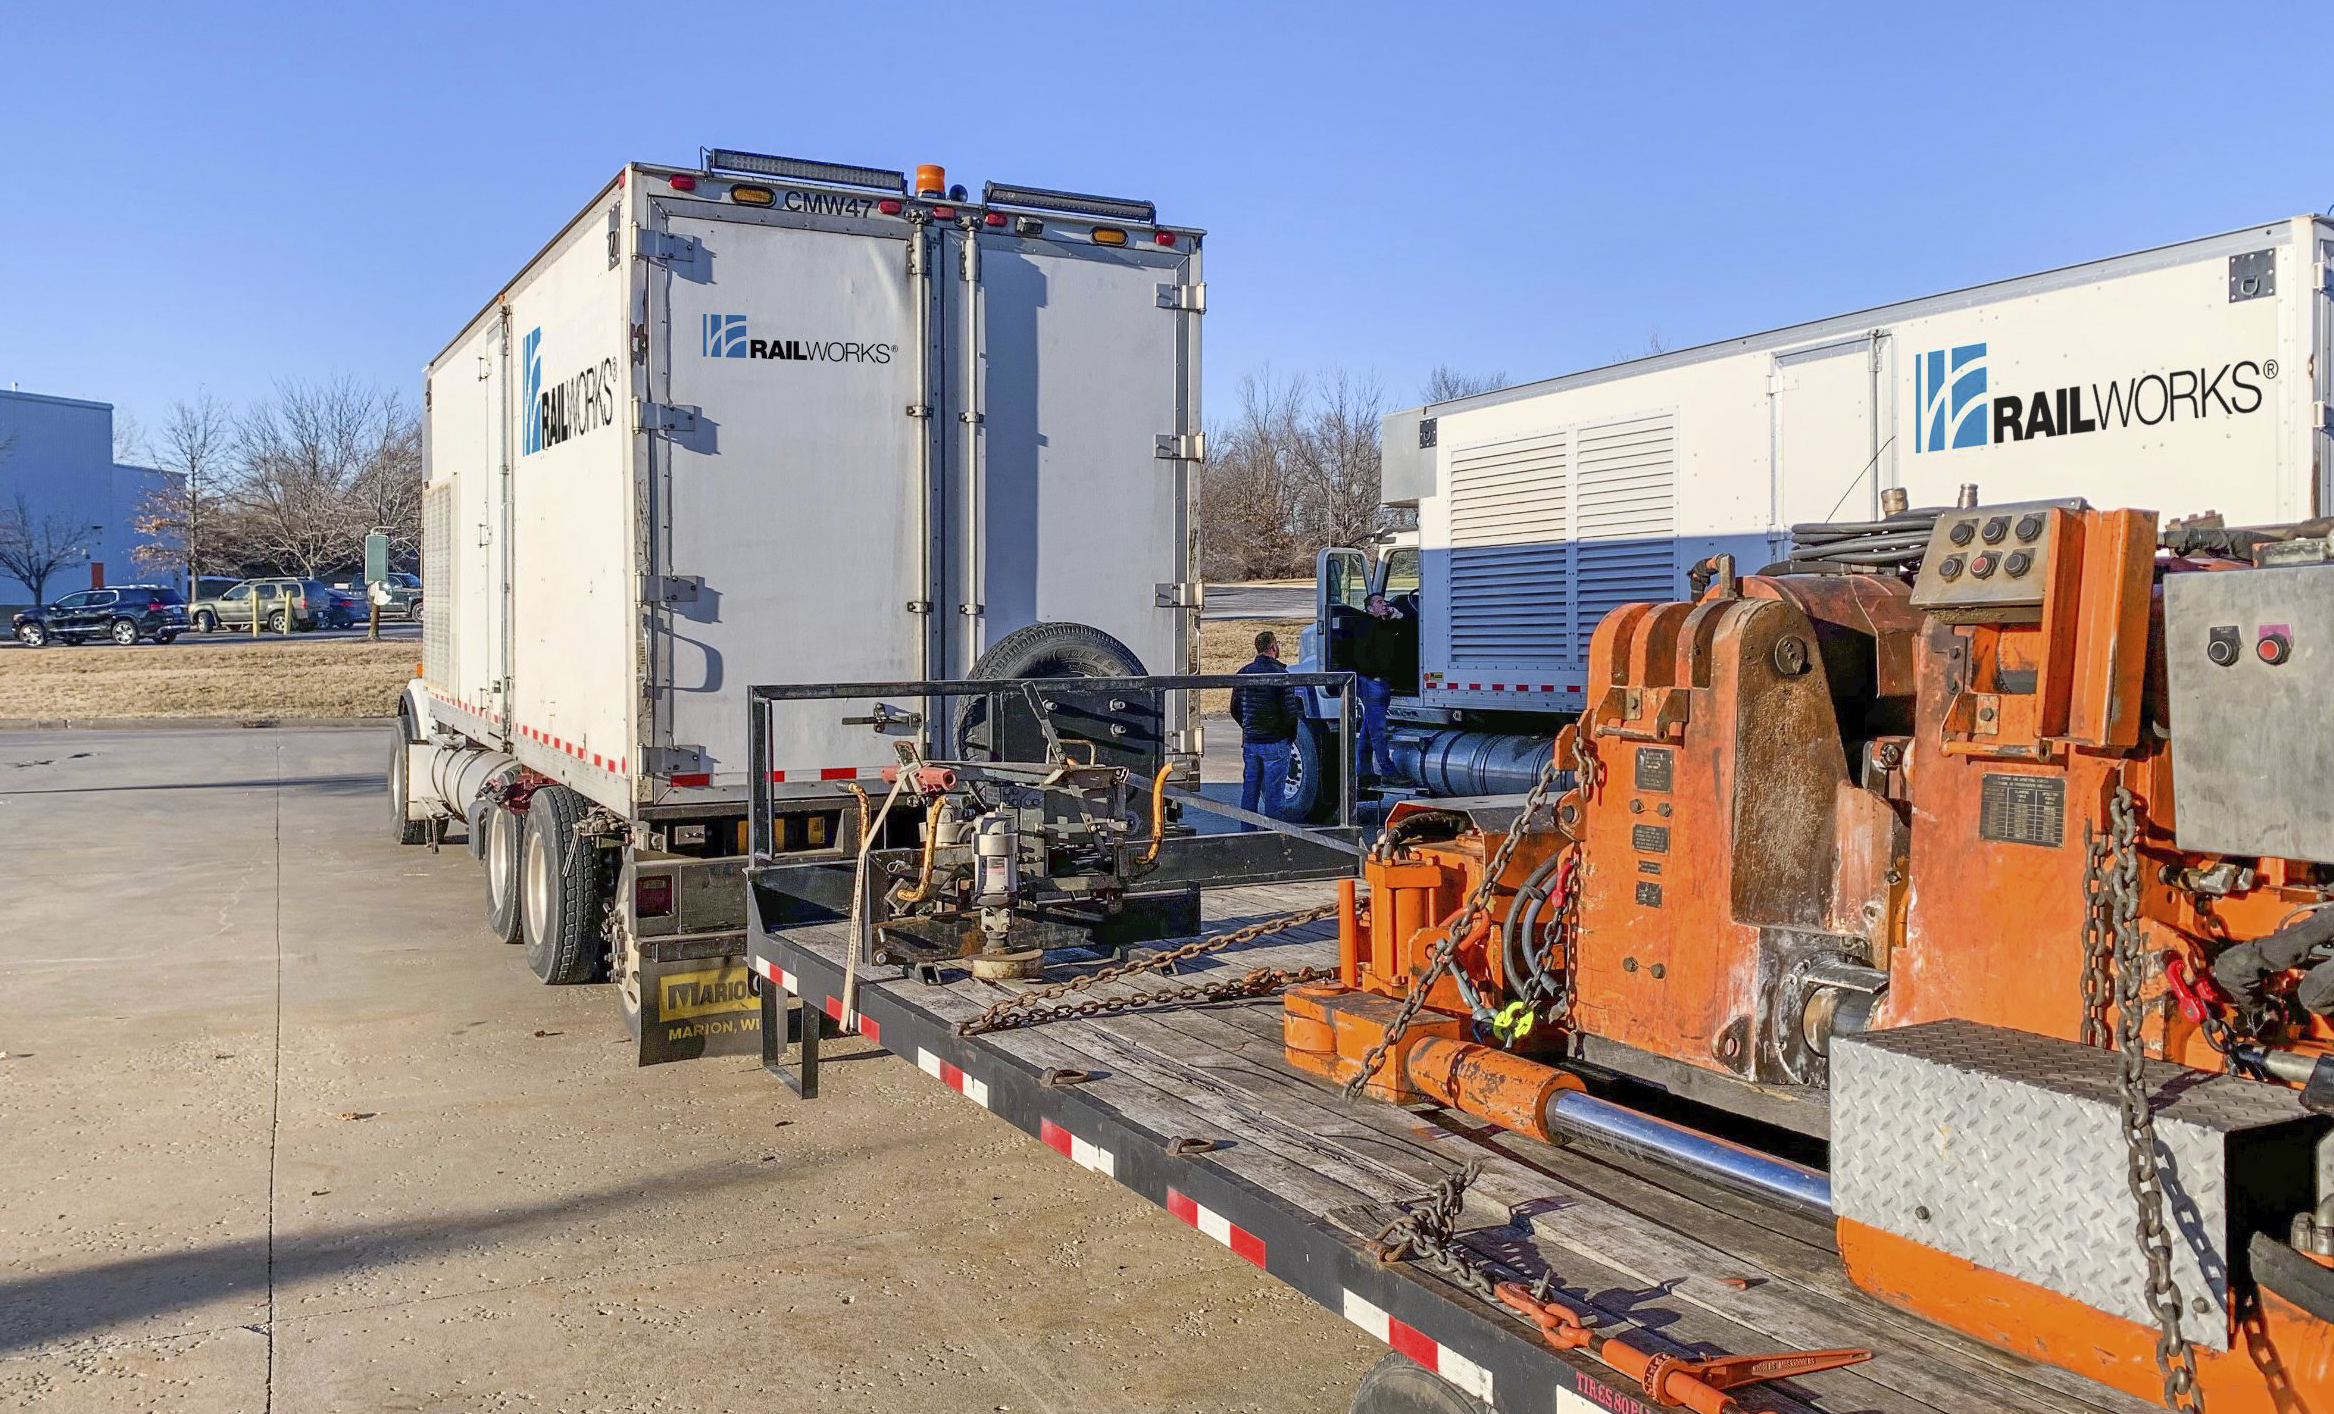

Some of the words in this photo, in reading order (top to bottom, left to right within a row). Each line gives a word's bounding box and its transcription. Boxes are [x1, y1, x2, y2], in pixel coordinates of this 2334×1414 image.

[784, 190, 873, 218] CMW47
[667, 980, 753, 1010] MARIO
[668, 1021, 738, 1042] MARION,
